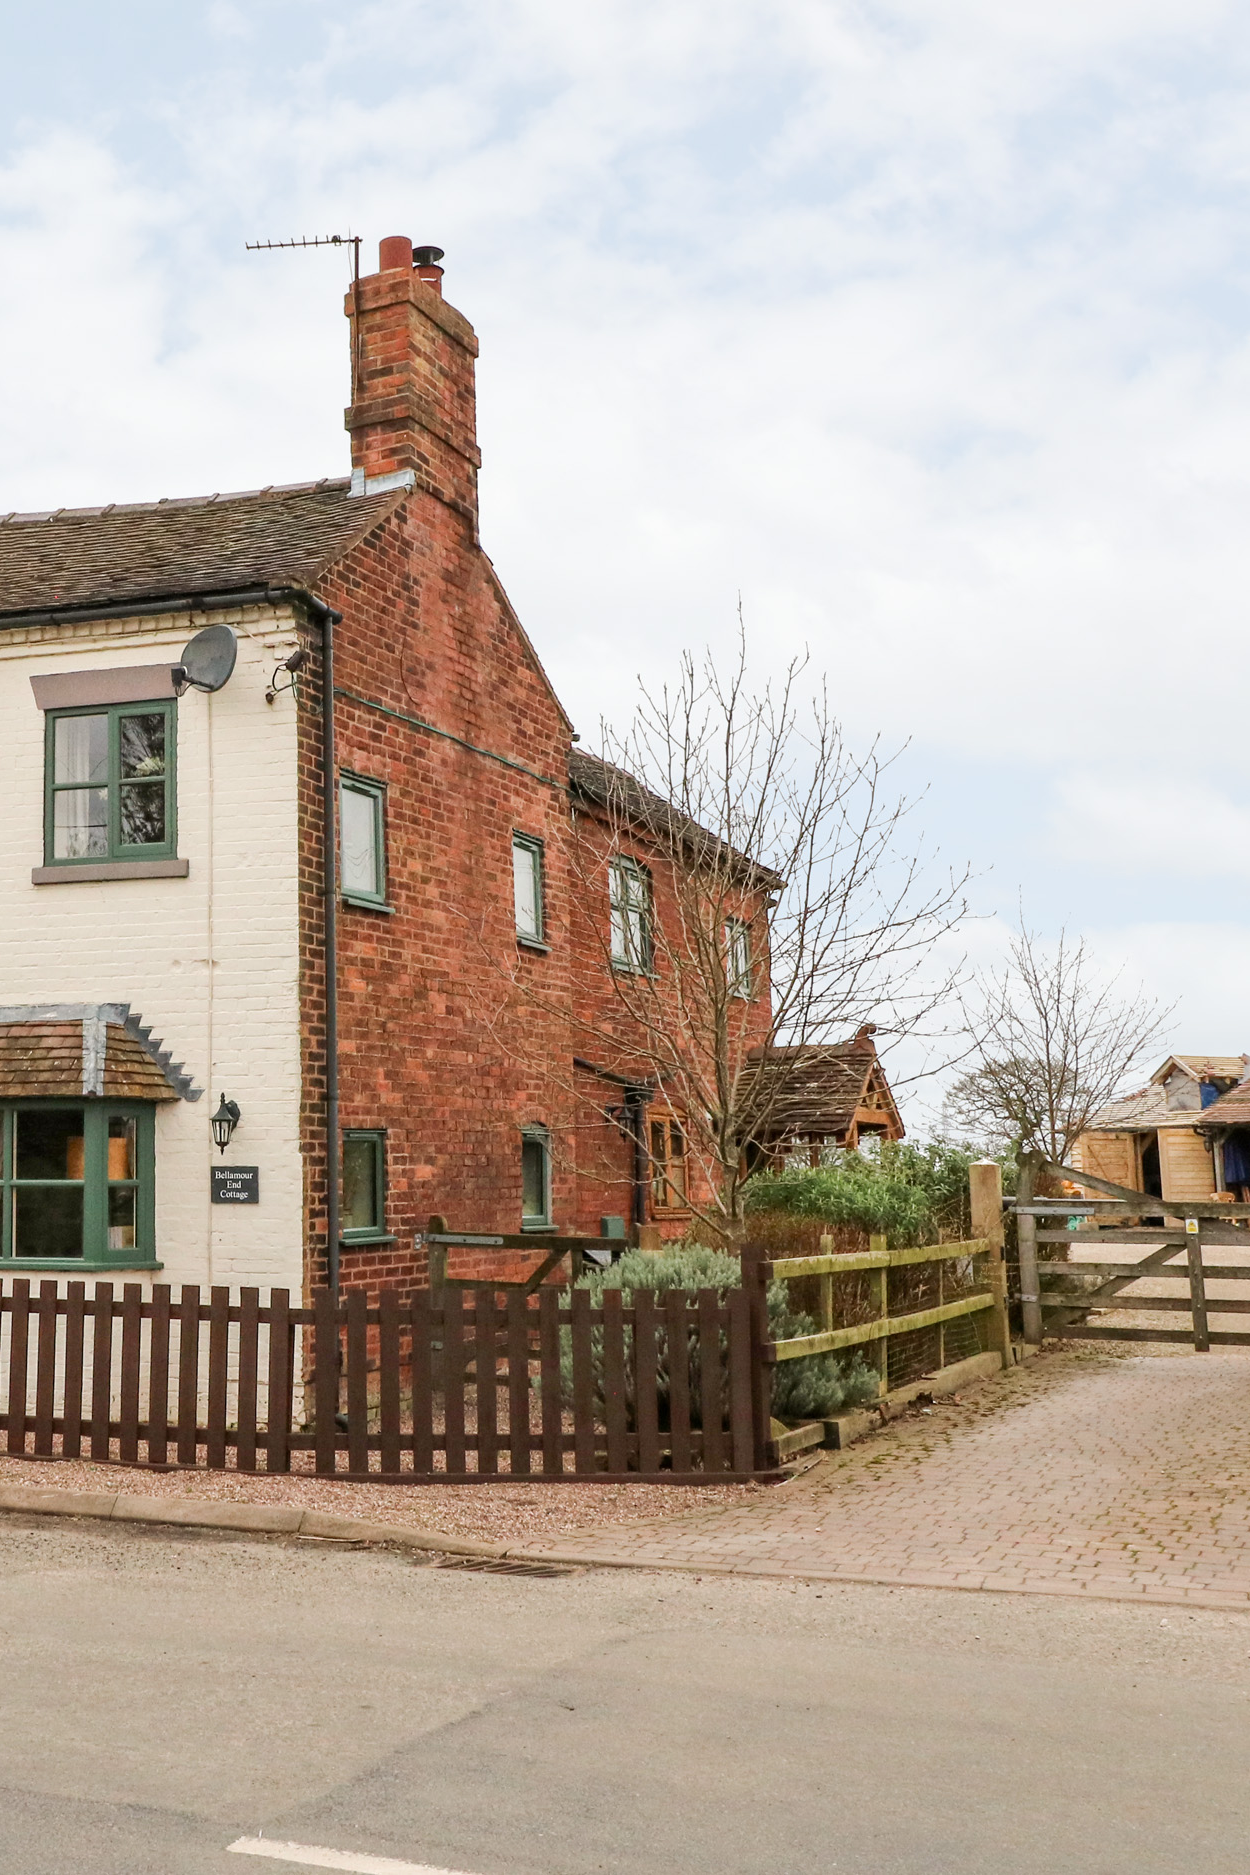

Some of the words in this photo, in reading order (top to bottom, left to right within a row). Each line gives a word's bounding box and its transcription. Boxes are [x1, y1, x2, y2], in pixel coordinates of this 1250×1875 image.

[215, 1171, 254, 1179] Bellamour
[226, 1180, 242, 1189] End
[220, 1190, 249, 1200] Cottage
